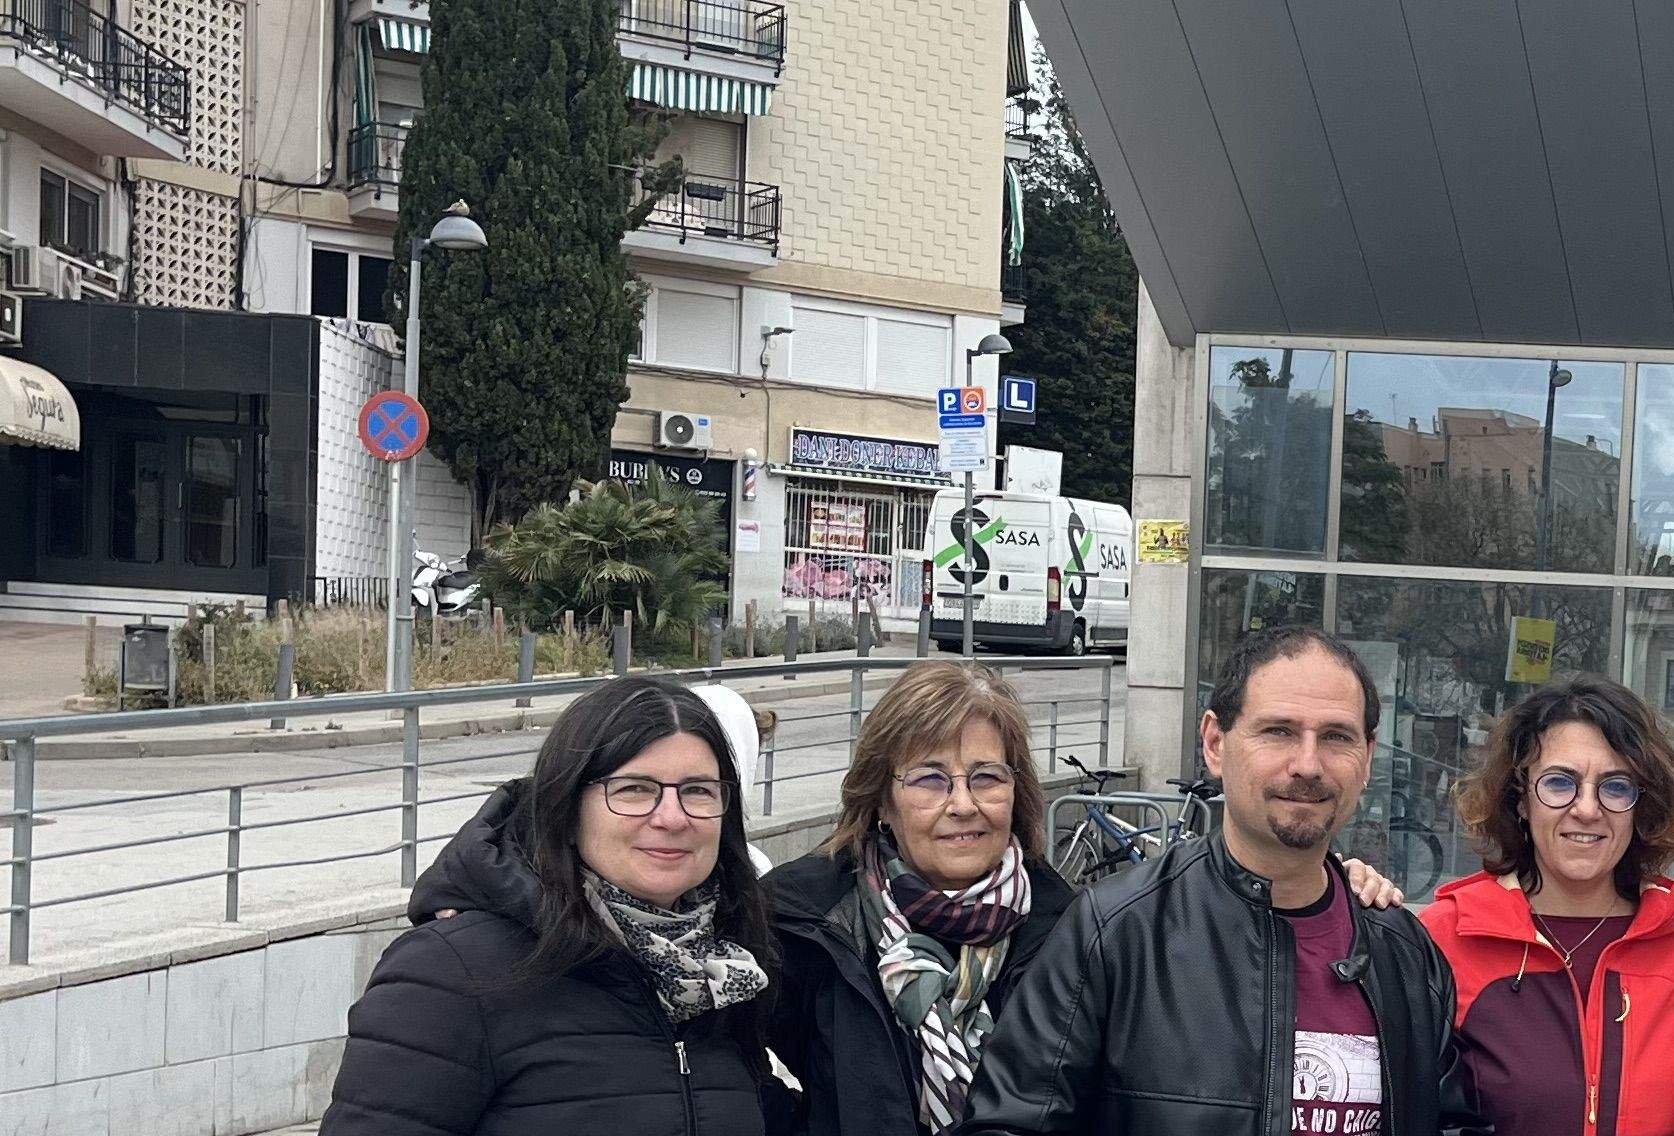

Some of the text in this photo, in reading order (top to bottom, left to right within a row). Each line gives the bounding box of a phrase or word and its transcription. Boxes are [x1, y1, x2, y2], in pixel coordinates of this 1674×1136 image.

[943, 392, 957, 411] P
[1010, 382, 1028, 408] L
[994, 529, 1041, 547] SASA
[1100, 543, 1127, 571] SASA
[1311, 1108, 1337, 1133] NO
